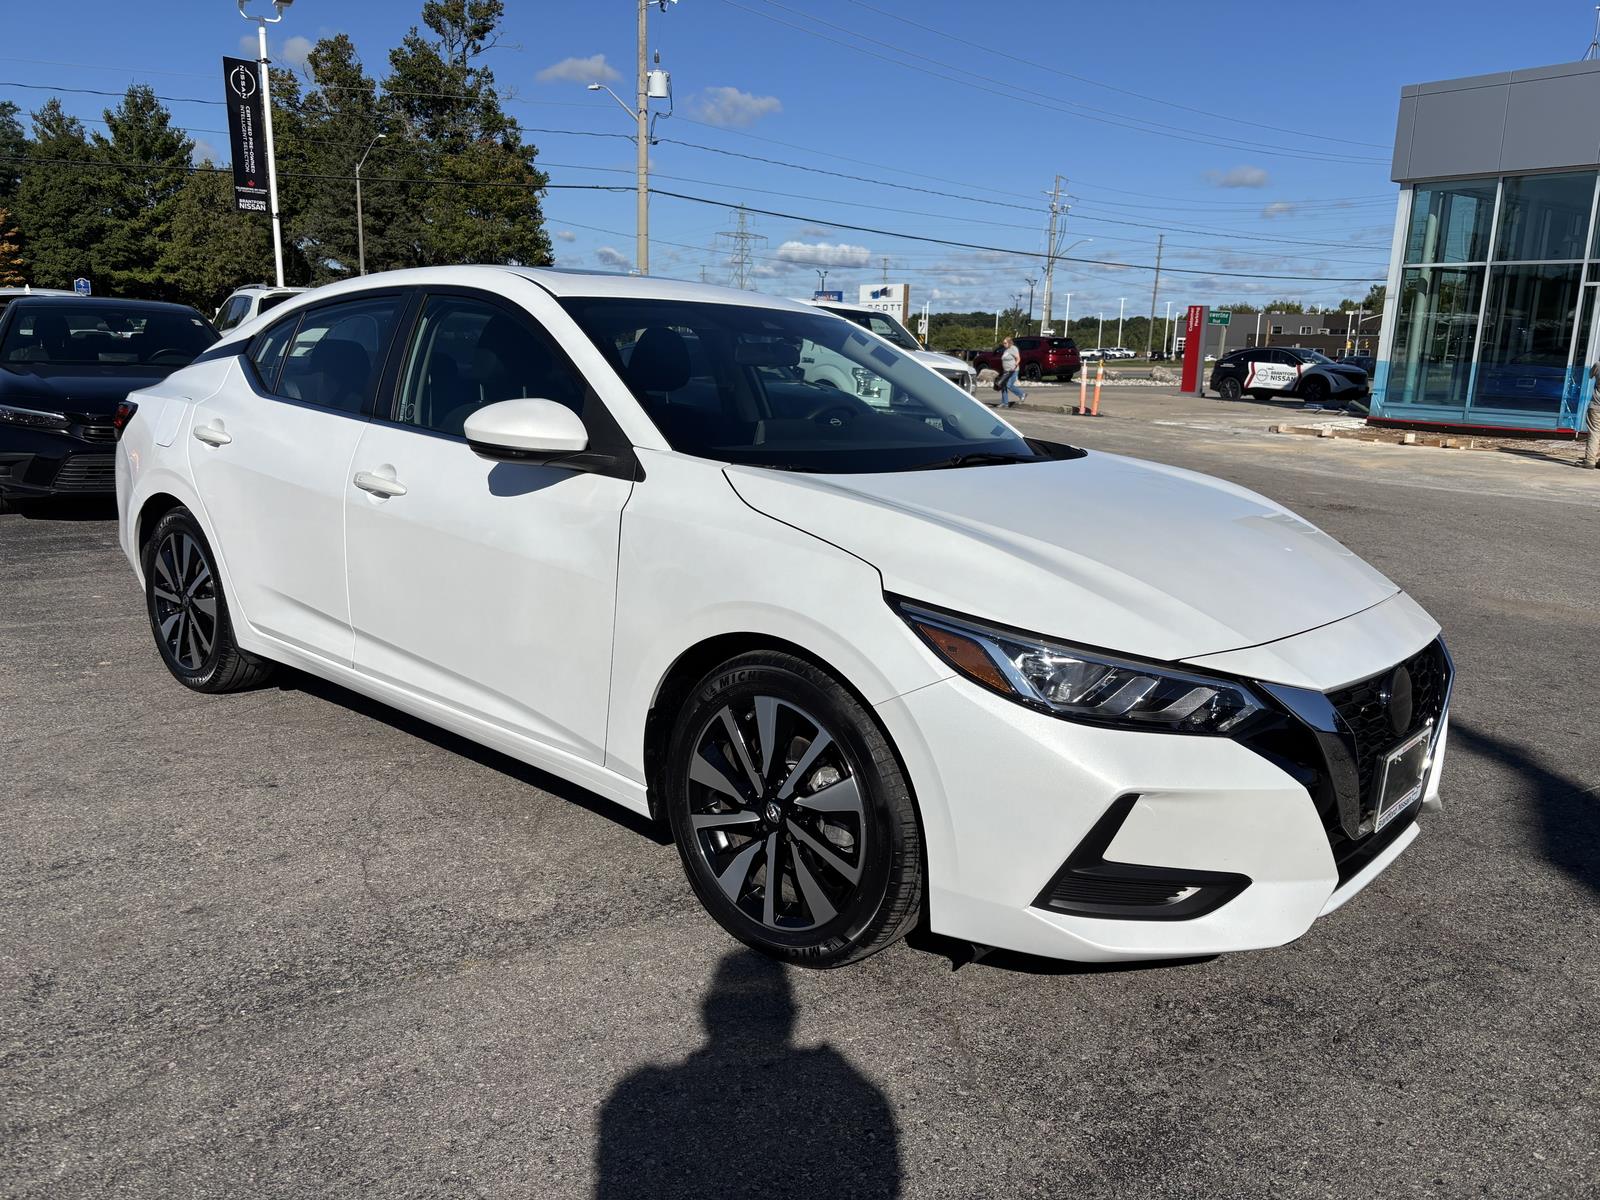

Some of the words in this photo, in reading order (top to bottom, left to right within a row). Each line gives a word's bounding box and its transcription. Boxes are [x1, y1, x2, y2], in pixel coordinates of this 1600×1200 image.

[239, 65, 247, 99] NISSAN
[239, 104, 248, 141] INTELLIGENT
[245, 105, 253, 136] CERTIFIED
[248, 136, 256, 174] PRE-OWNED
[239, 203, 266, 211] NISSAN
[1270, 375, 1297, 383] NISSAN
